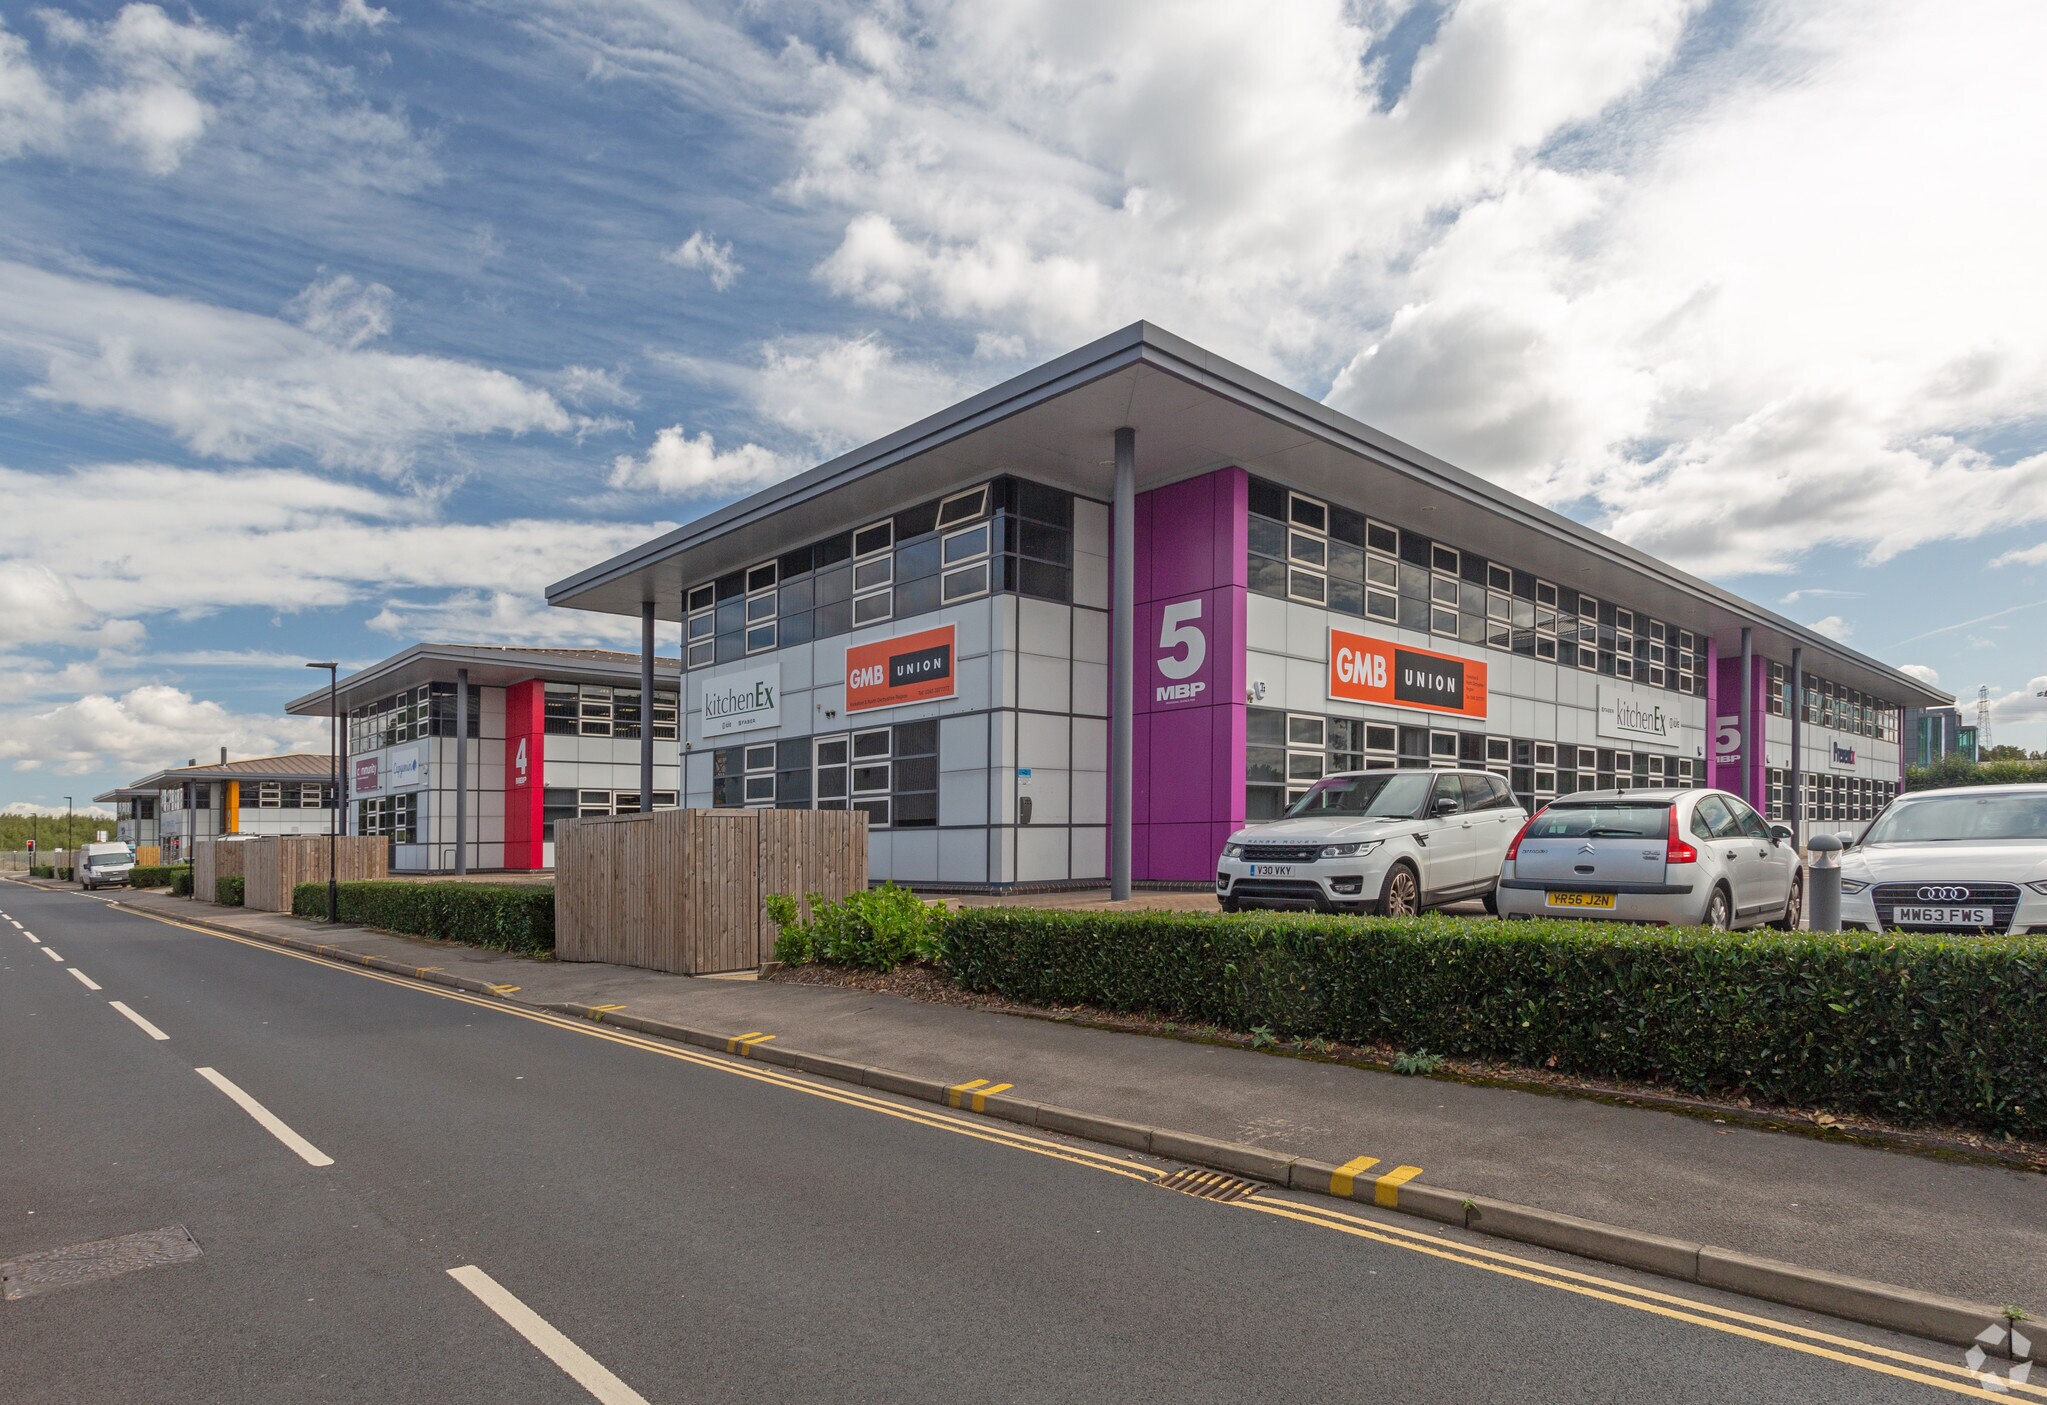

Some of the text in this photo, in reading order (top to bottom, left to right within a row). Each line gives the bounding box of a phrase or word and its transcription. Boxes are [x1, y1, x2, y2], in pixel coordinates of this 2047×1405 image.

[1157, 598, 1206, 680] 5
[849, 657, 942, 689] GMB UNION
[1336, 647, 1455, 693] GMB UNION
[705, 681, 775, 717] kitchenEx
[1156, 681, 1206, 702] MBP
[1617, 698, 1667, 737] kitchenEx
[1716, 715, 1742, 754] 5
[515, 738, 528, 775] 4
[1257, 866, 1292, 875] V30 VKY
[1553, 893, 1610, 906] YR56 JZN
[1900, 908, 1985, 922] MW63 FWS
